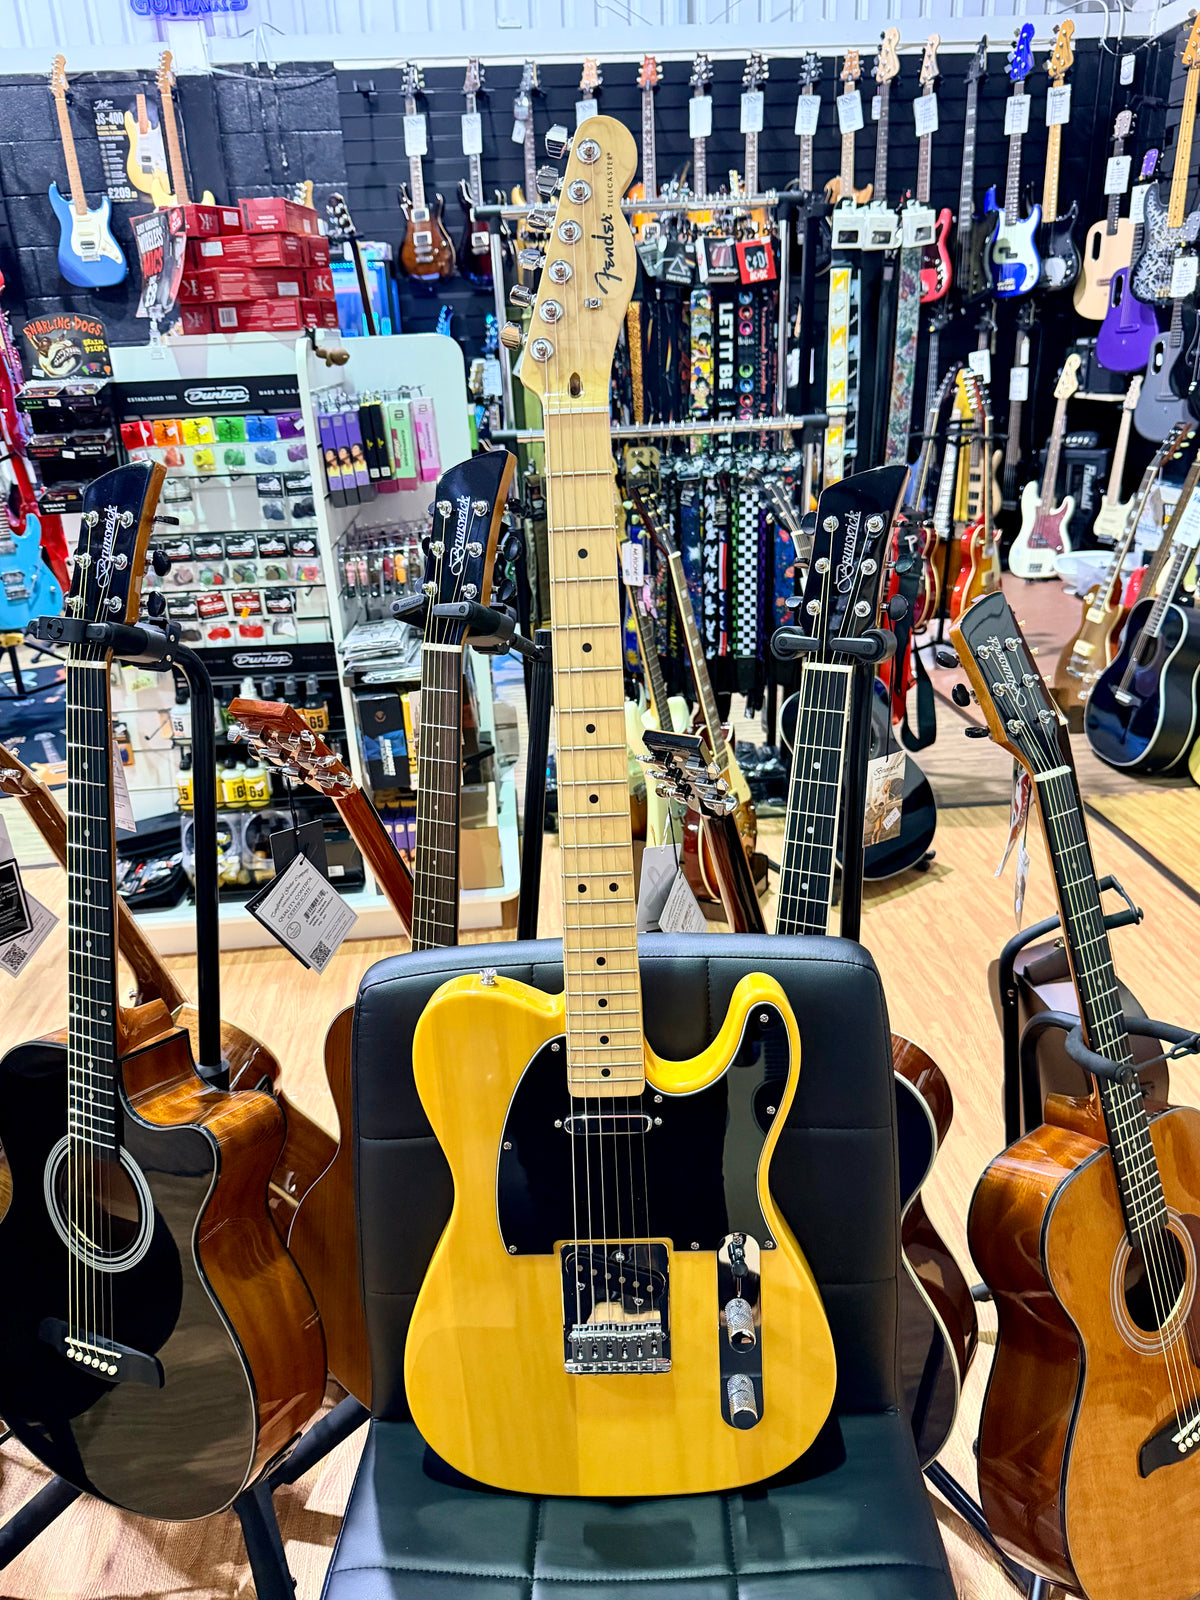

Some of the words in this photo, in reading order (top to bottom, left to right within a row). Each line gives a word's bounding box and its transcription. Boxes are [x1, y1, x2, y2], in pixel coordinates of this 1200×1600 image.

[107, 187, 131, 199] £209
[591, 213, 622, 294] Fender
[23, 317, 72, 339] SNARLING
[74, 315, 103, 337] DOGS
[718, 303, 734, 340] LET
[718, 364, 734, 390] BE
[188, 389, 246, 402] Dunlop
[1081, 464, 1097, 510] Randall
[95, 504, 118, 588] Brunswick
[449, 494, 471, 576] Brunswick
[834, 510, 861, 593] Brunswick
[236, 654, 292, 665] Dunlop
[309, 715, 325, 729] 65
[277, 900, 295, 923] QUALITY
[294, 875, 313, 900] CONTROL
[286, 886, 311, 919] CERTIFICATE
